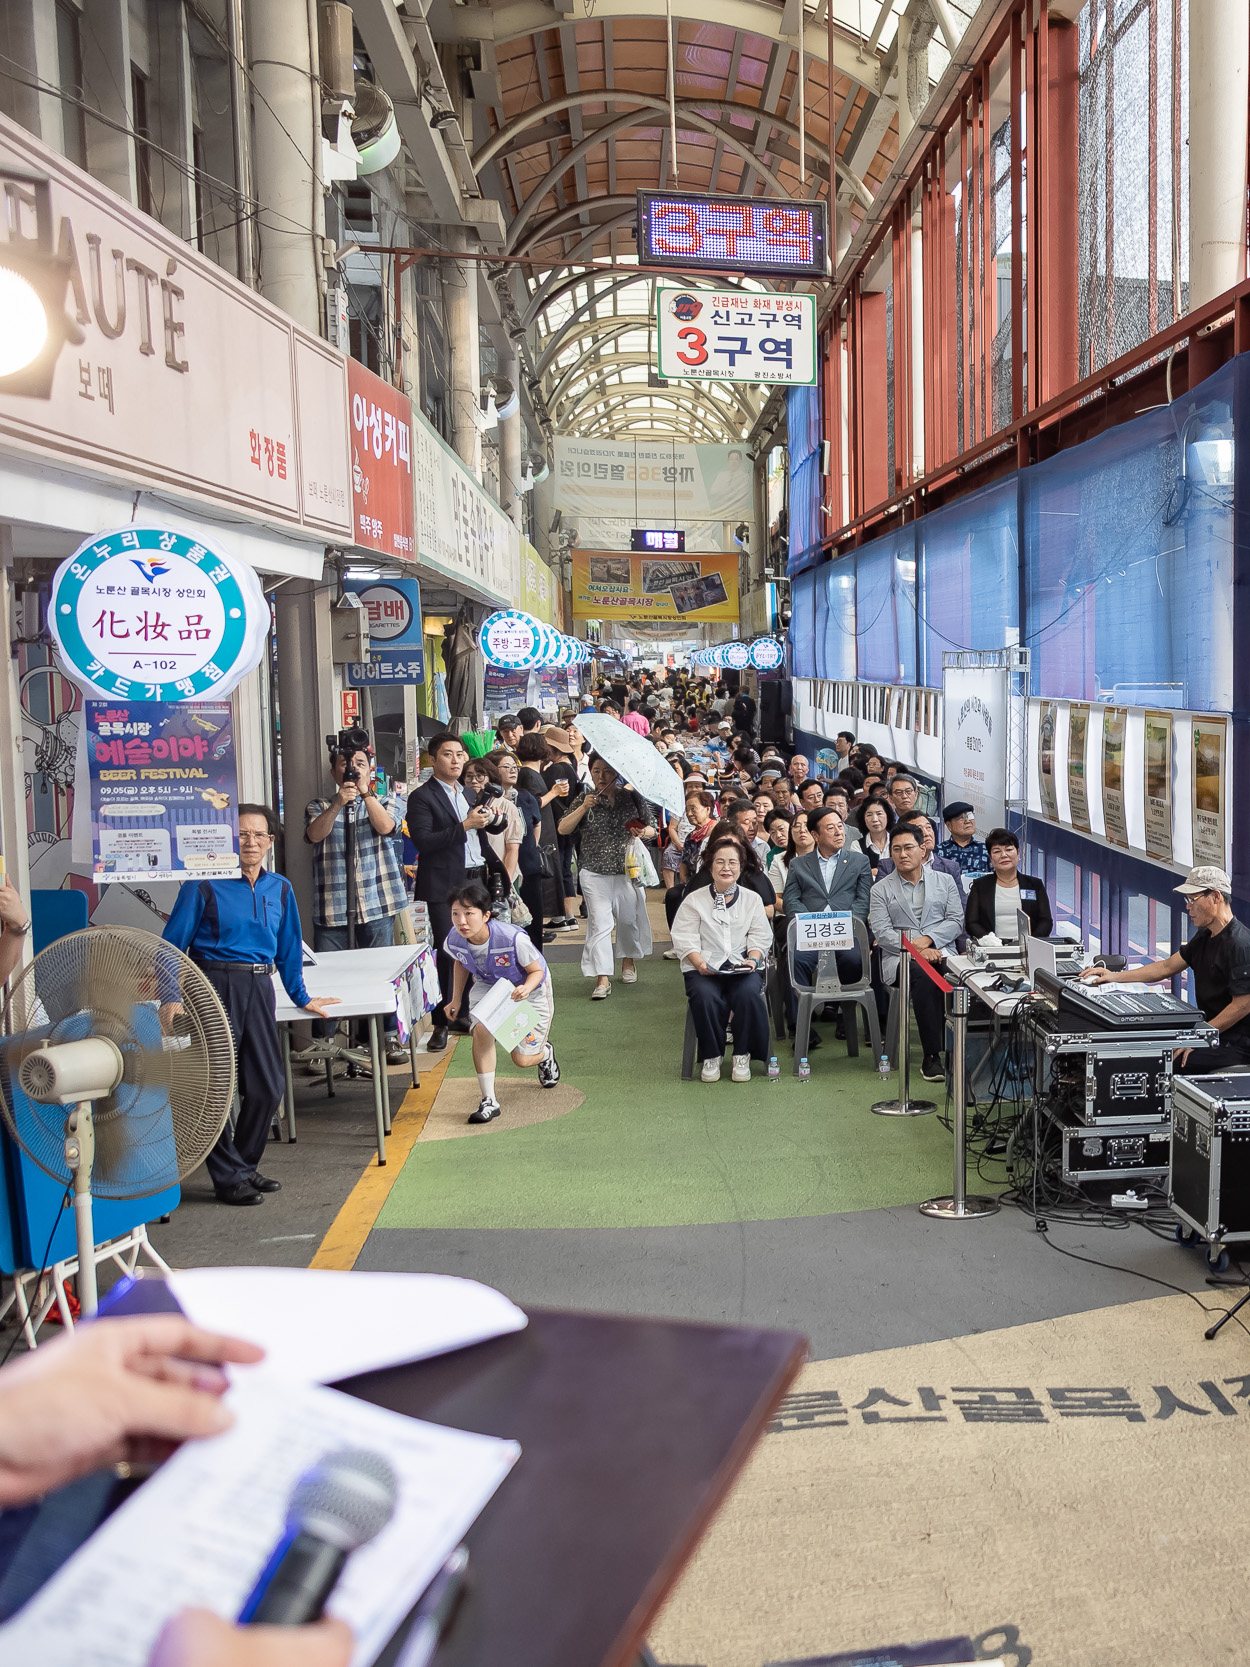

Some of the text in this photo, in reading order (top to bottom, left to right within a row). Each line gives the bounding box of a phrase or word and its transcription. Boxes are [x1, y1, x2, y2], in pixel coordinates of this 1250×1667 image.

[655, 205, 811, 261] 3구역
[712, 296, 803, 312] 긴급재난 화재 발생시
[710, 310, 802, 330] 신고구역
[676, 326, 793, 369] 3구역
[683, 368, 792, 380] 노룬산골목시장 광진소방서
[78, 358, 114, 414] 보떼
[353, 392, 411, 473] 아성커피
[249, 428, 287, 480] 화장품
[69, 531, 231, 585] 온누리상품권
[96, 585, 206, 599] 노룬산 골목시장 상인회
[592, 596, 653, 606] 노룬산골목시장
[133, 660, 177, 670] A-102
[352, 662, 421, 679] 하이트소주
[86, 659, 224, 702] 카드가맹점
[94, 709, 130, 722] 노룬산
[98, 722, 152, 736] 골목시장
[95, 735, 209, 765] 예술이야
[99, 768, 208, 781] BEER FESTIVAL
[140, 786, 156, 795] 오후
[158, 786, 171, 794] 5시
[180, 785, 193, 794] 9시
[804, 922, 846, 938] 김경호
